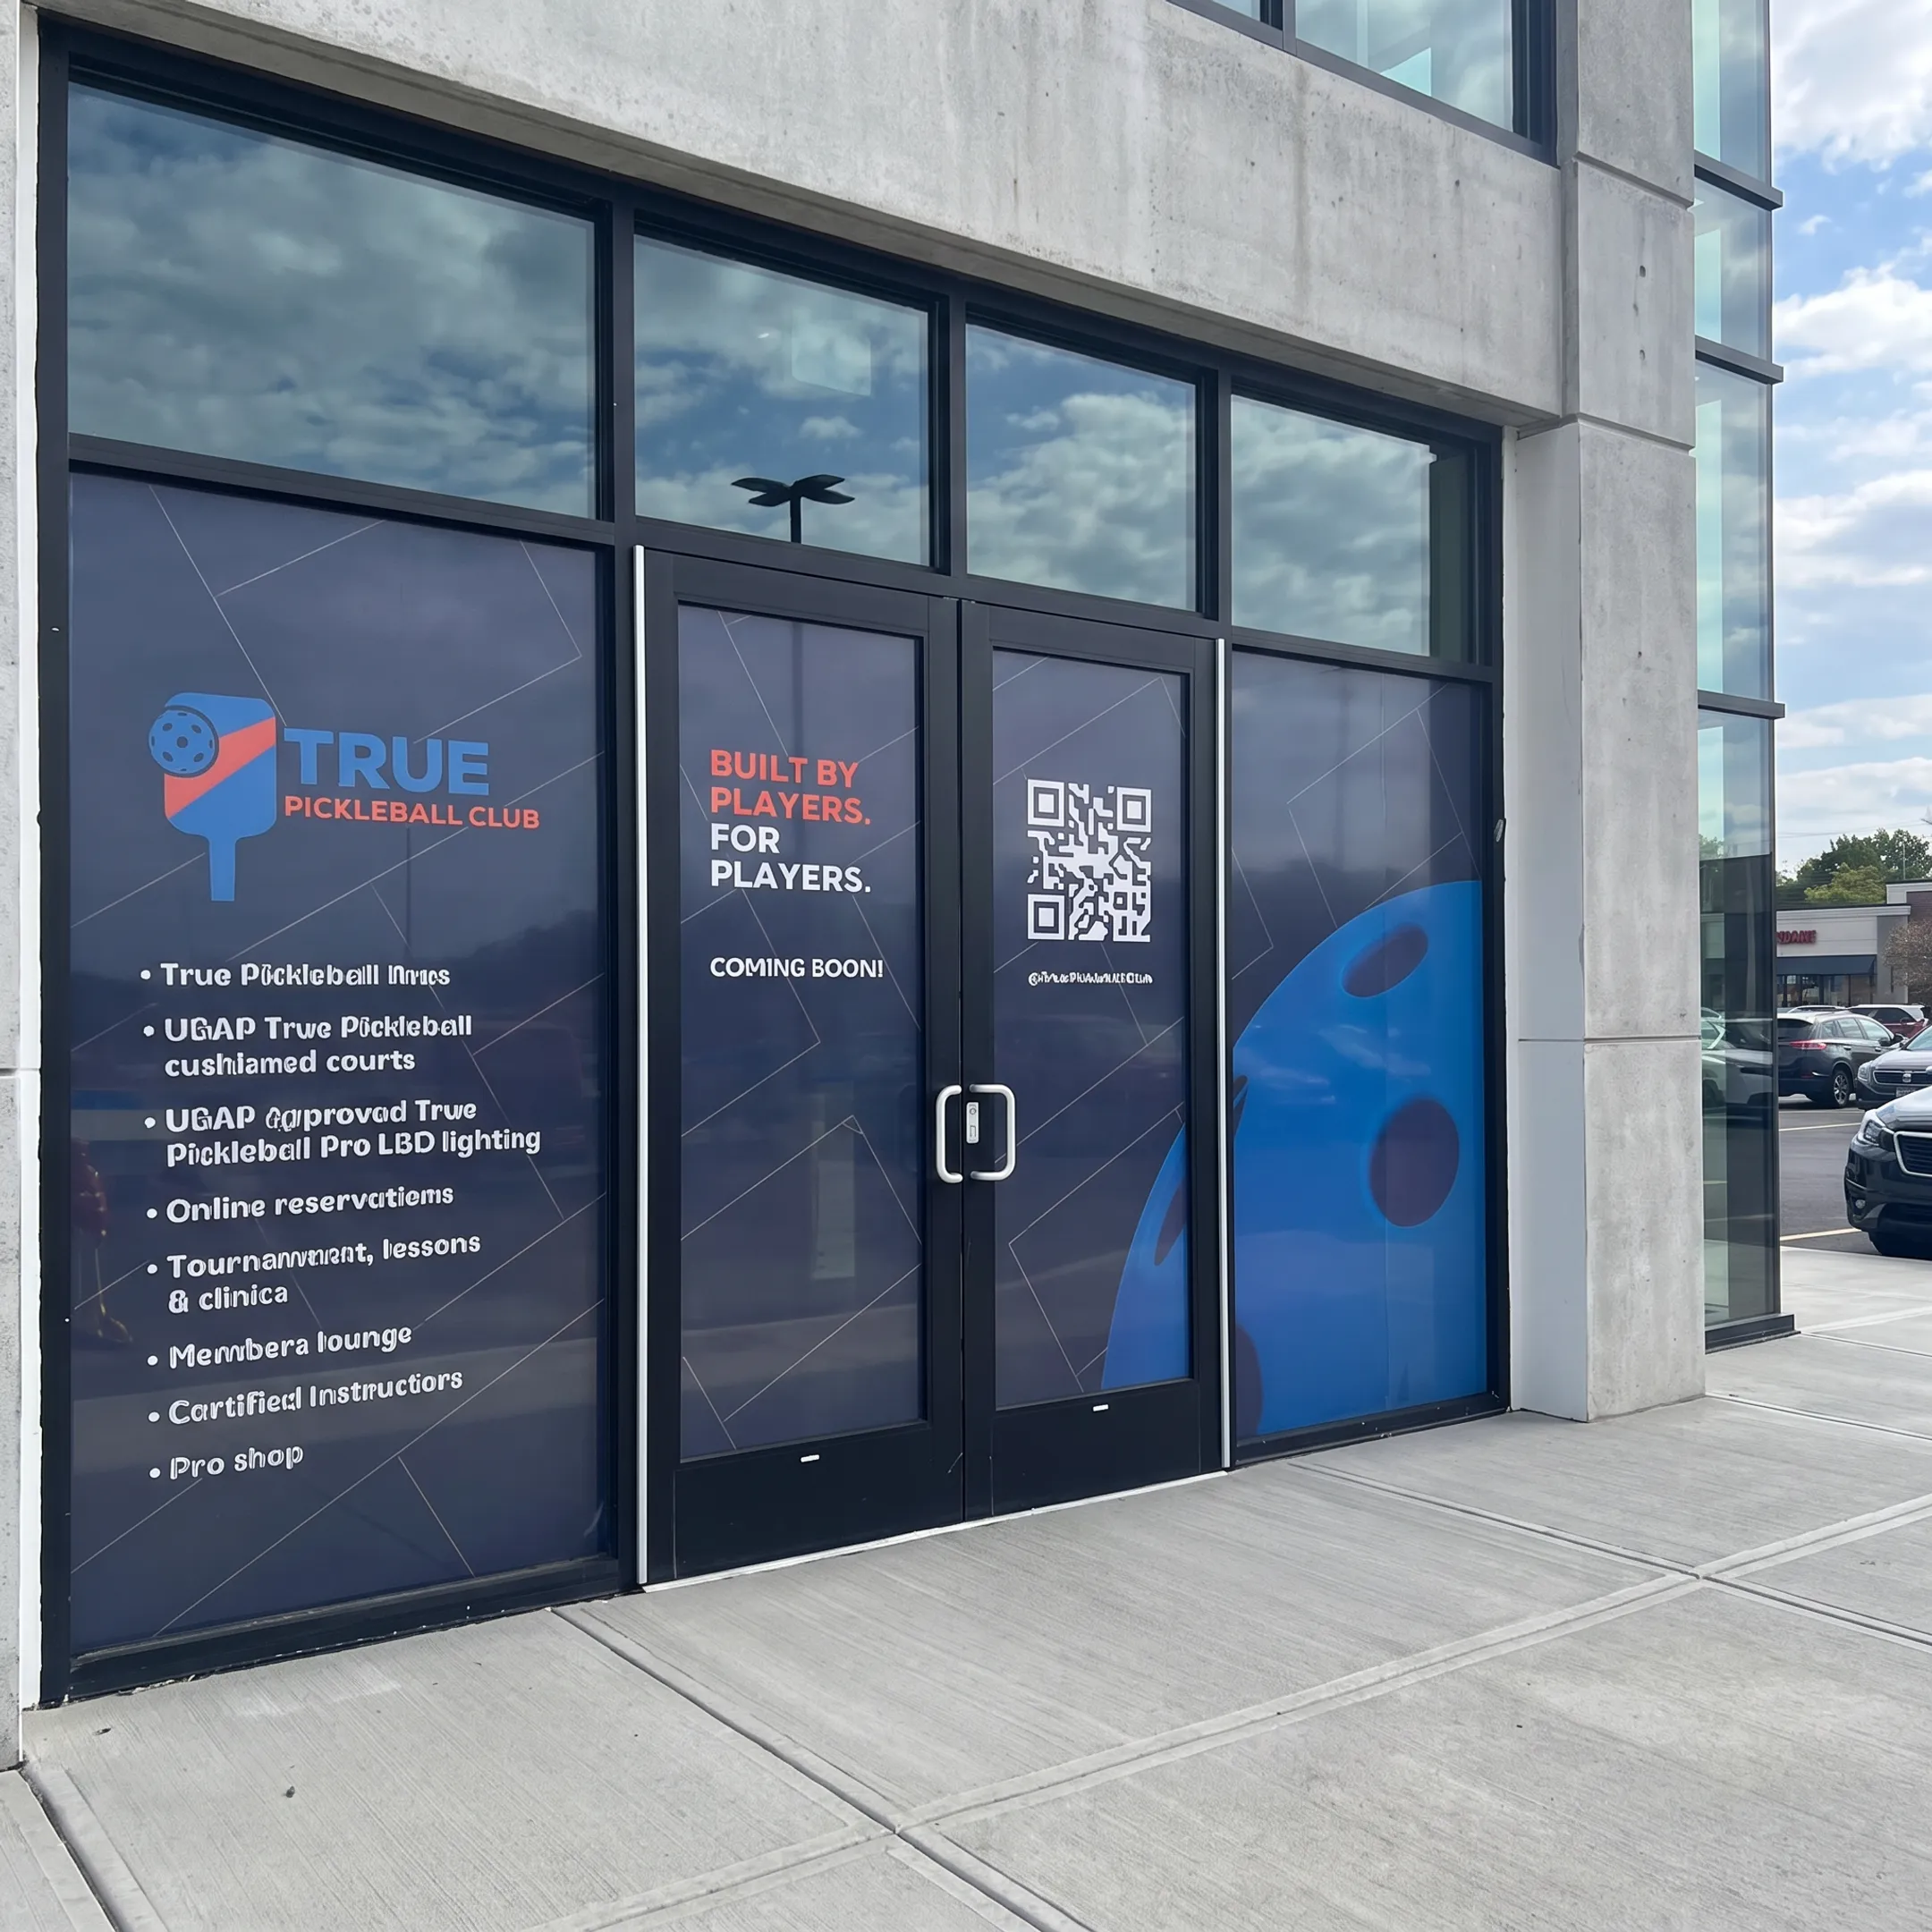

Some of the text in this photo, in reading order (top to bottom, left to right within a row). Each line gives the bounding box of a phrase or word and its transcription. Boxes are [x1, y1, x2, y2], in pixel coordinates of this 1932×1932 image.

[284, 727, 489, 796] TRUE
[710, 749, 859, 788] BUILT BY
[284, 795, 540, 830] PICKLEBALL CLUB
[710, 786, 871, 825] PLAYERS.
[711, 822, 780, 854] FOR
[711, 859, 871, 893] PLAYERS.
[160, 962, 232, 987] True
[710, 957, 884, 978] COMING BOON!
[326, 1050, 416, 1072] courts
[167, 1136, 310, 1167] Pickleball
[320, 1135, 371, 1158] Pro
[442, 1128, 540, 1158] lighting
[166, 1196, 266, 1223] Online
[383, 1235, 481, 1259] lessons
[318, 1326, 412, 1353] lounge
[170, 1445, 304, 1480] Pro shop
